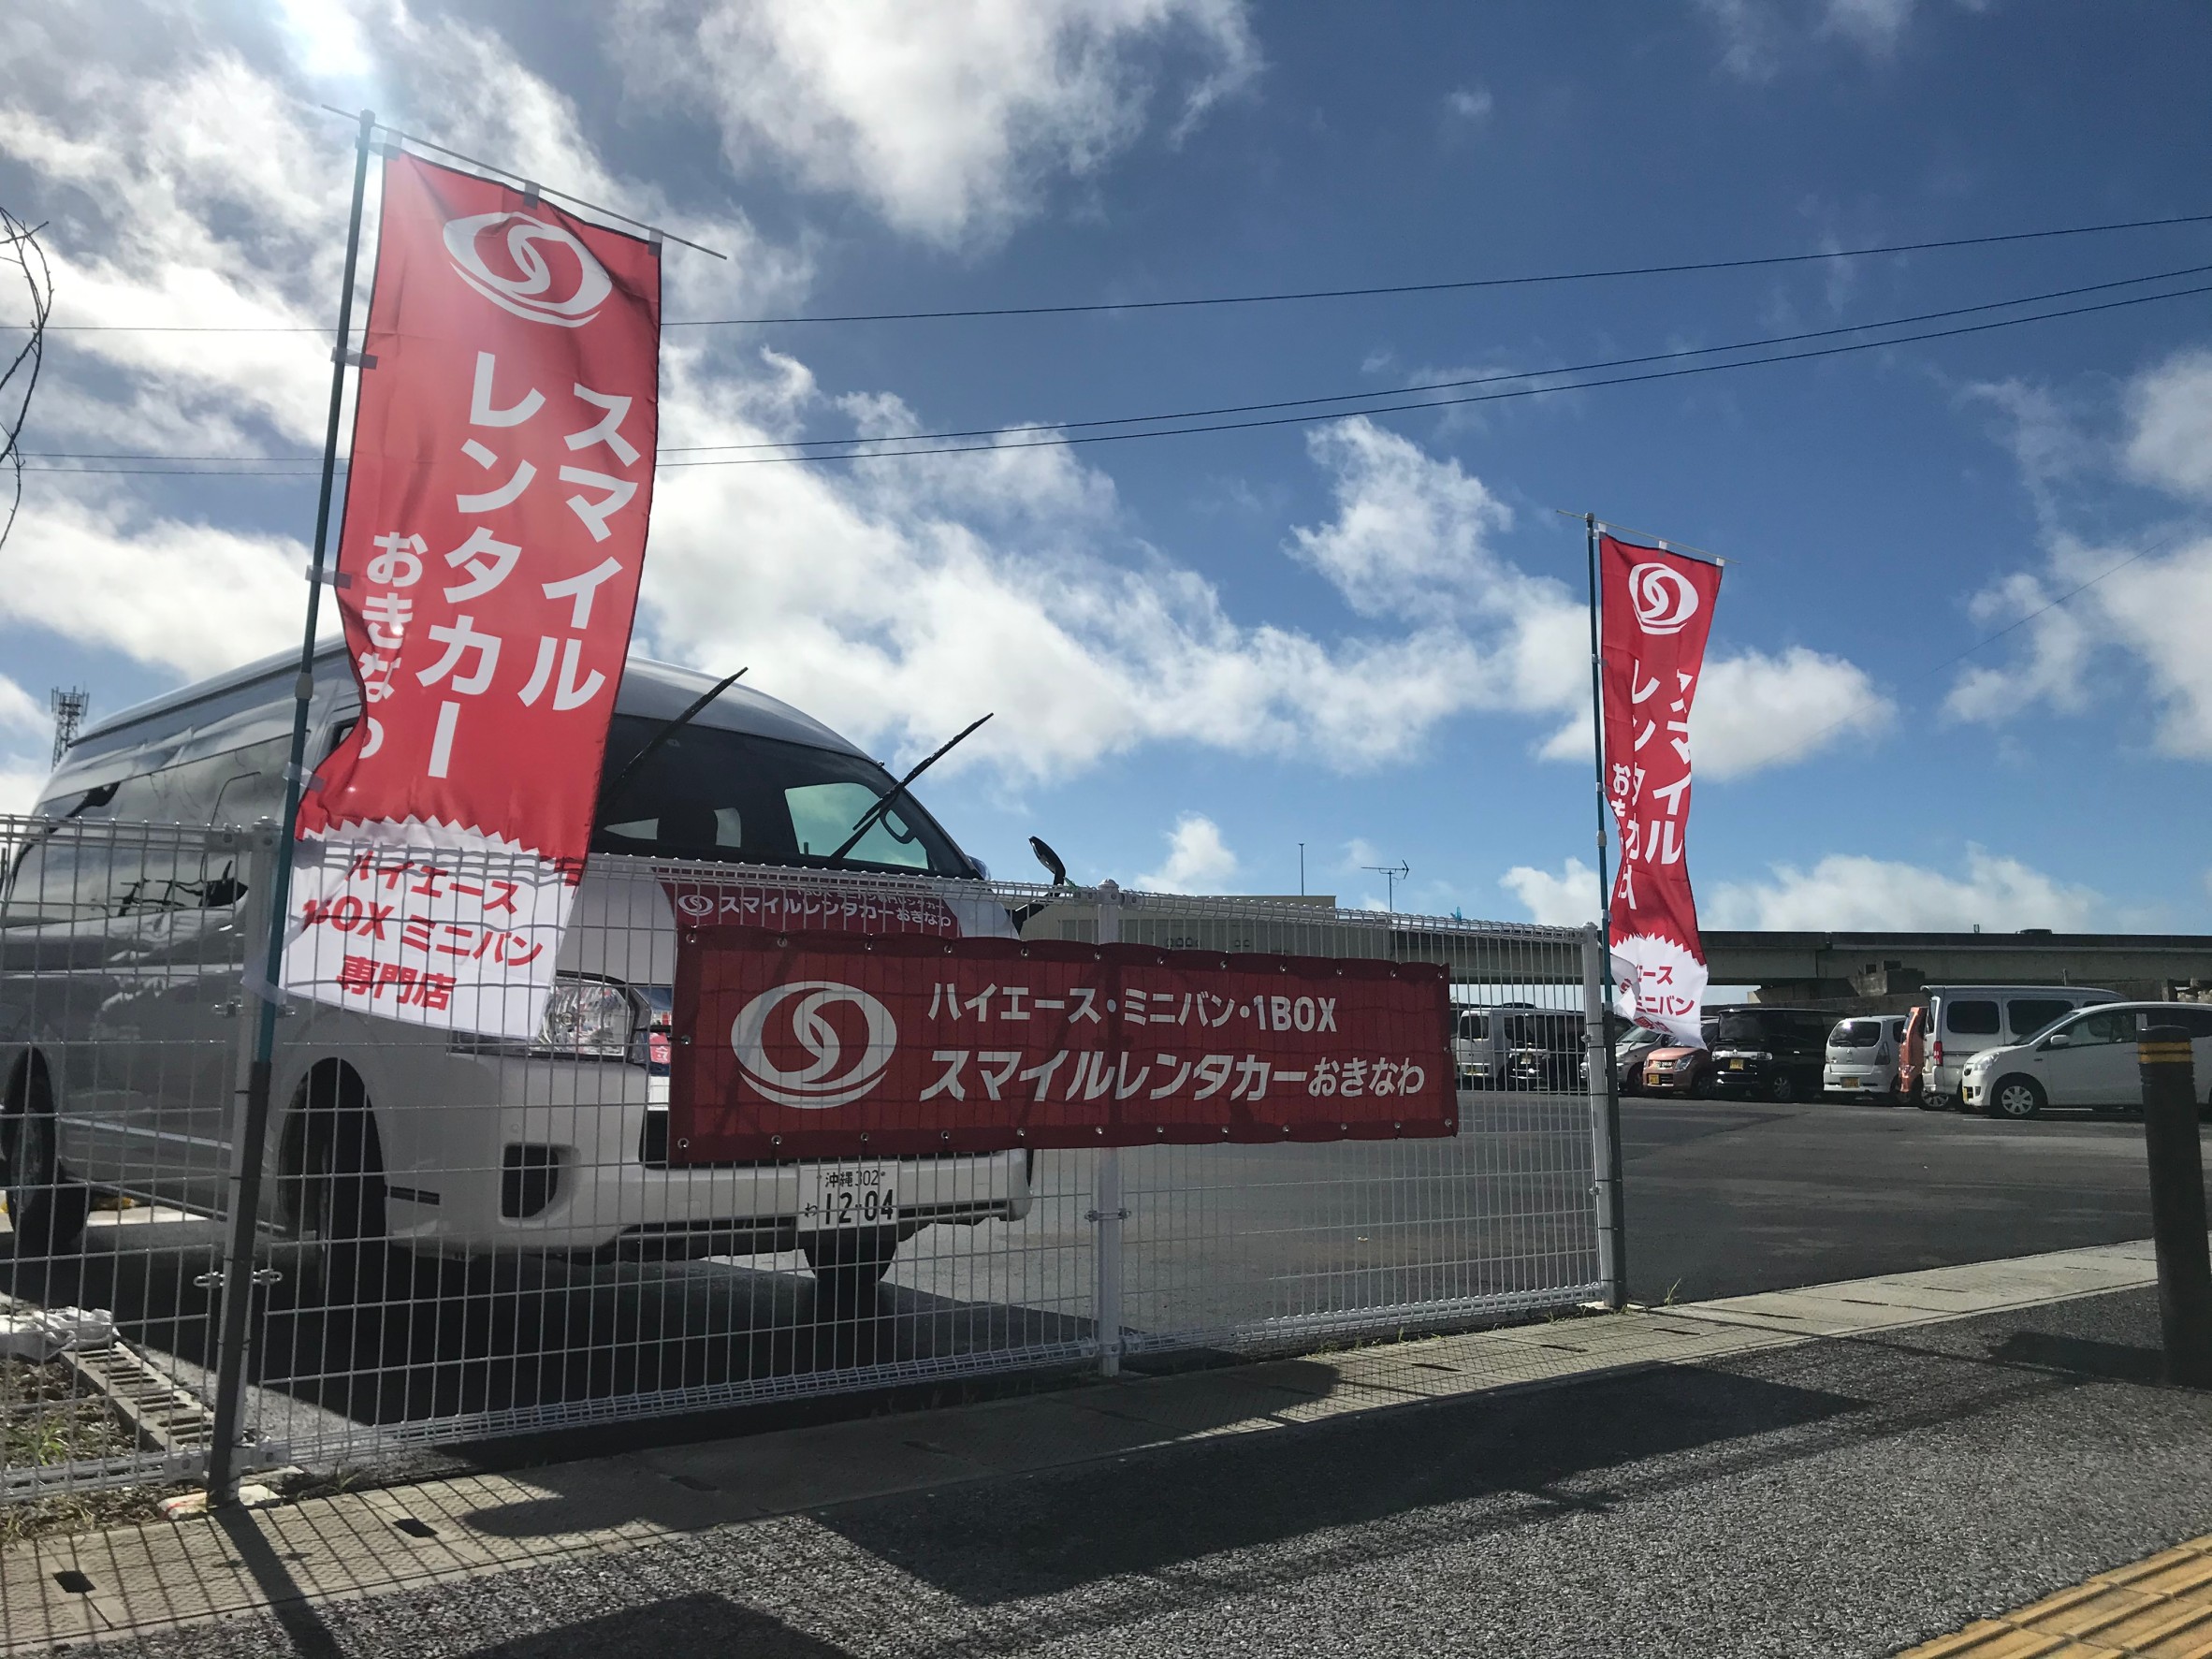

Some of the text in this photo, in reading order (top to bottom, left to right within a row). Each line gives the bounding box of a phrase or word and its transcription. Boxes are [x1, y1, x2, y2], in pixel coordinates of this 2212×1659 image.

[415, 351, 546, 779] レンタカー
[517, 382, 641, 711] スマイル
[345, 851, 518, 914] ハイエース
[401, 914, 543, 966] ミニバン
[720, 896, 952, 927] スマイルレンタカーおきなわ
[336, 954, 457, 1011] 専門店
[919, 1050, 1425, 1102] スマイルレンタカーおきなわ
